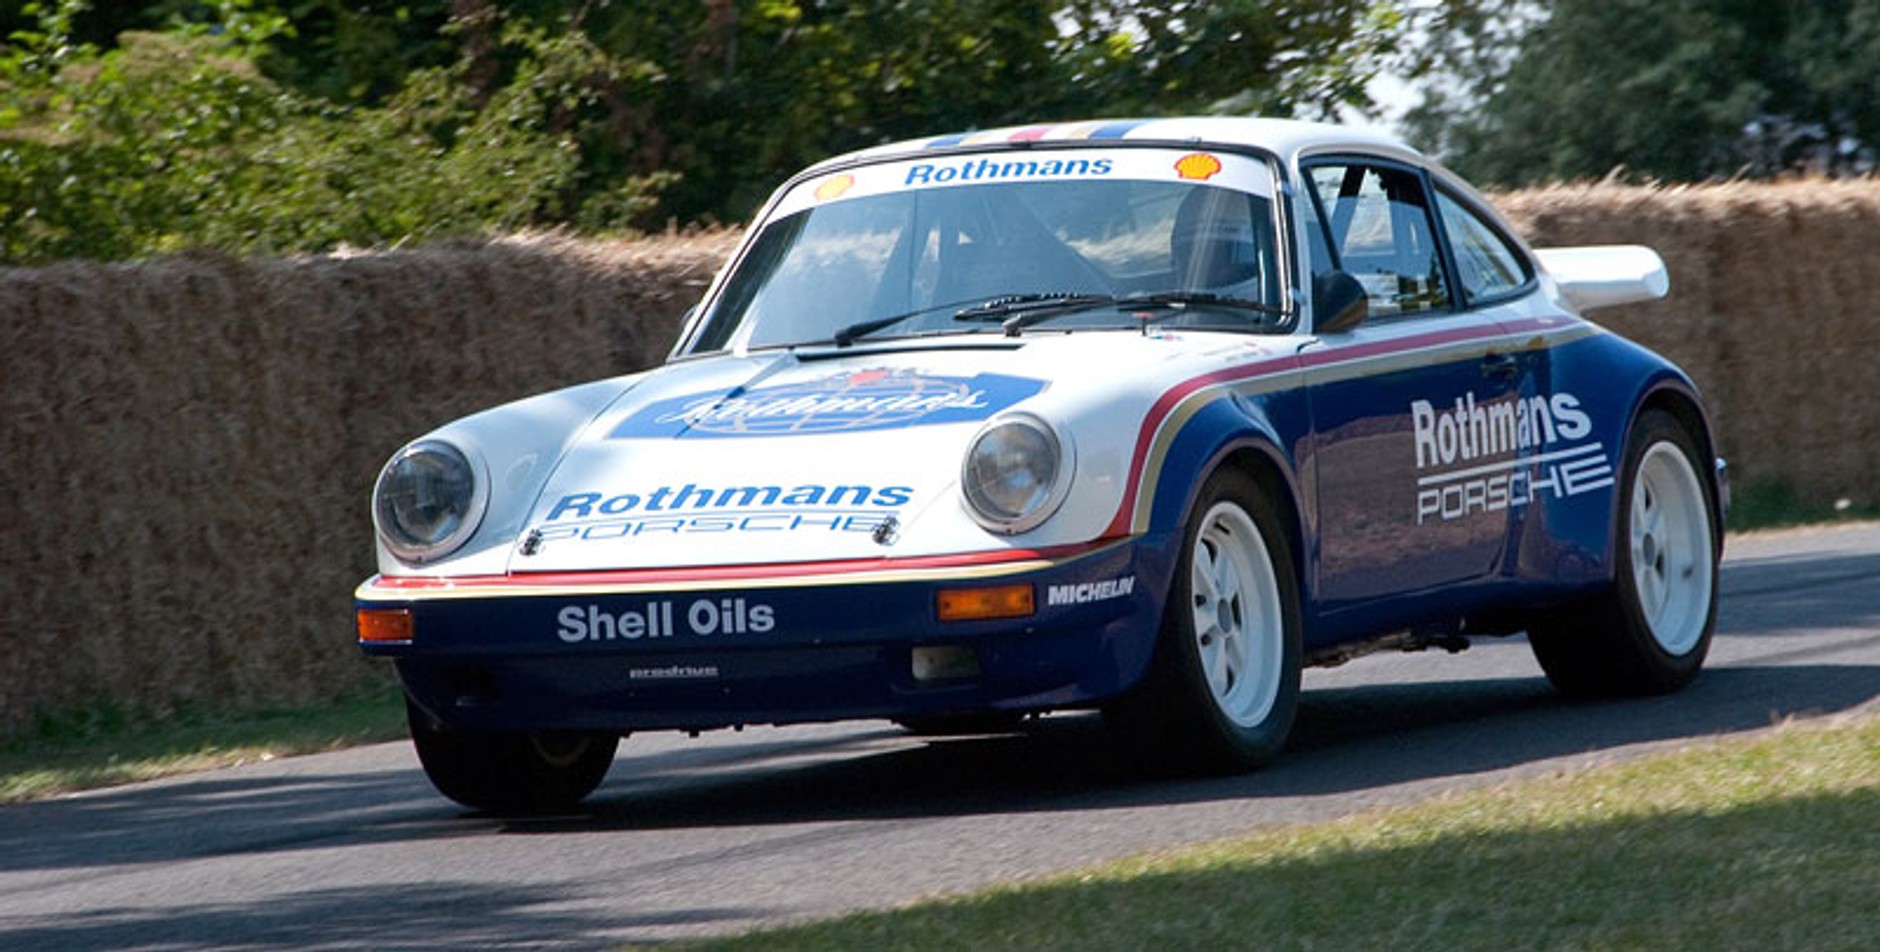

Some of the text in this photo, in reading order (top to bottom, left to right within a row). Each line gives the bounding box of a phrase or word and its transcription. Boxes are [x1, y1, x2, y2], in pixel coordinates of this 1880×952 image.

[904, 157, 1113, 186] Rothmans
[1411, 391, 1592, 468] Rothmans
[546, 484, 913, 520] Rothmans
[1417, 454, 1615, 525] PORSCHE
[538, 514, 889, 541] PORSCHE
[1048, 576, 1135, 605] MICHELIN
[557, 598, 775, 642] Shell Oils
